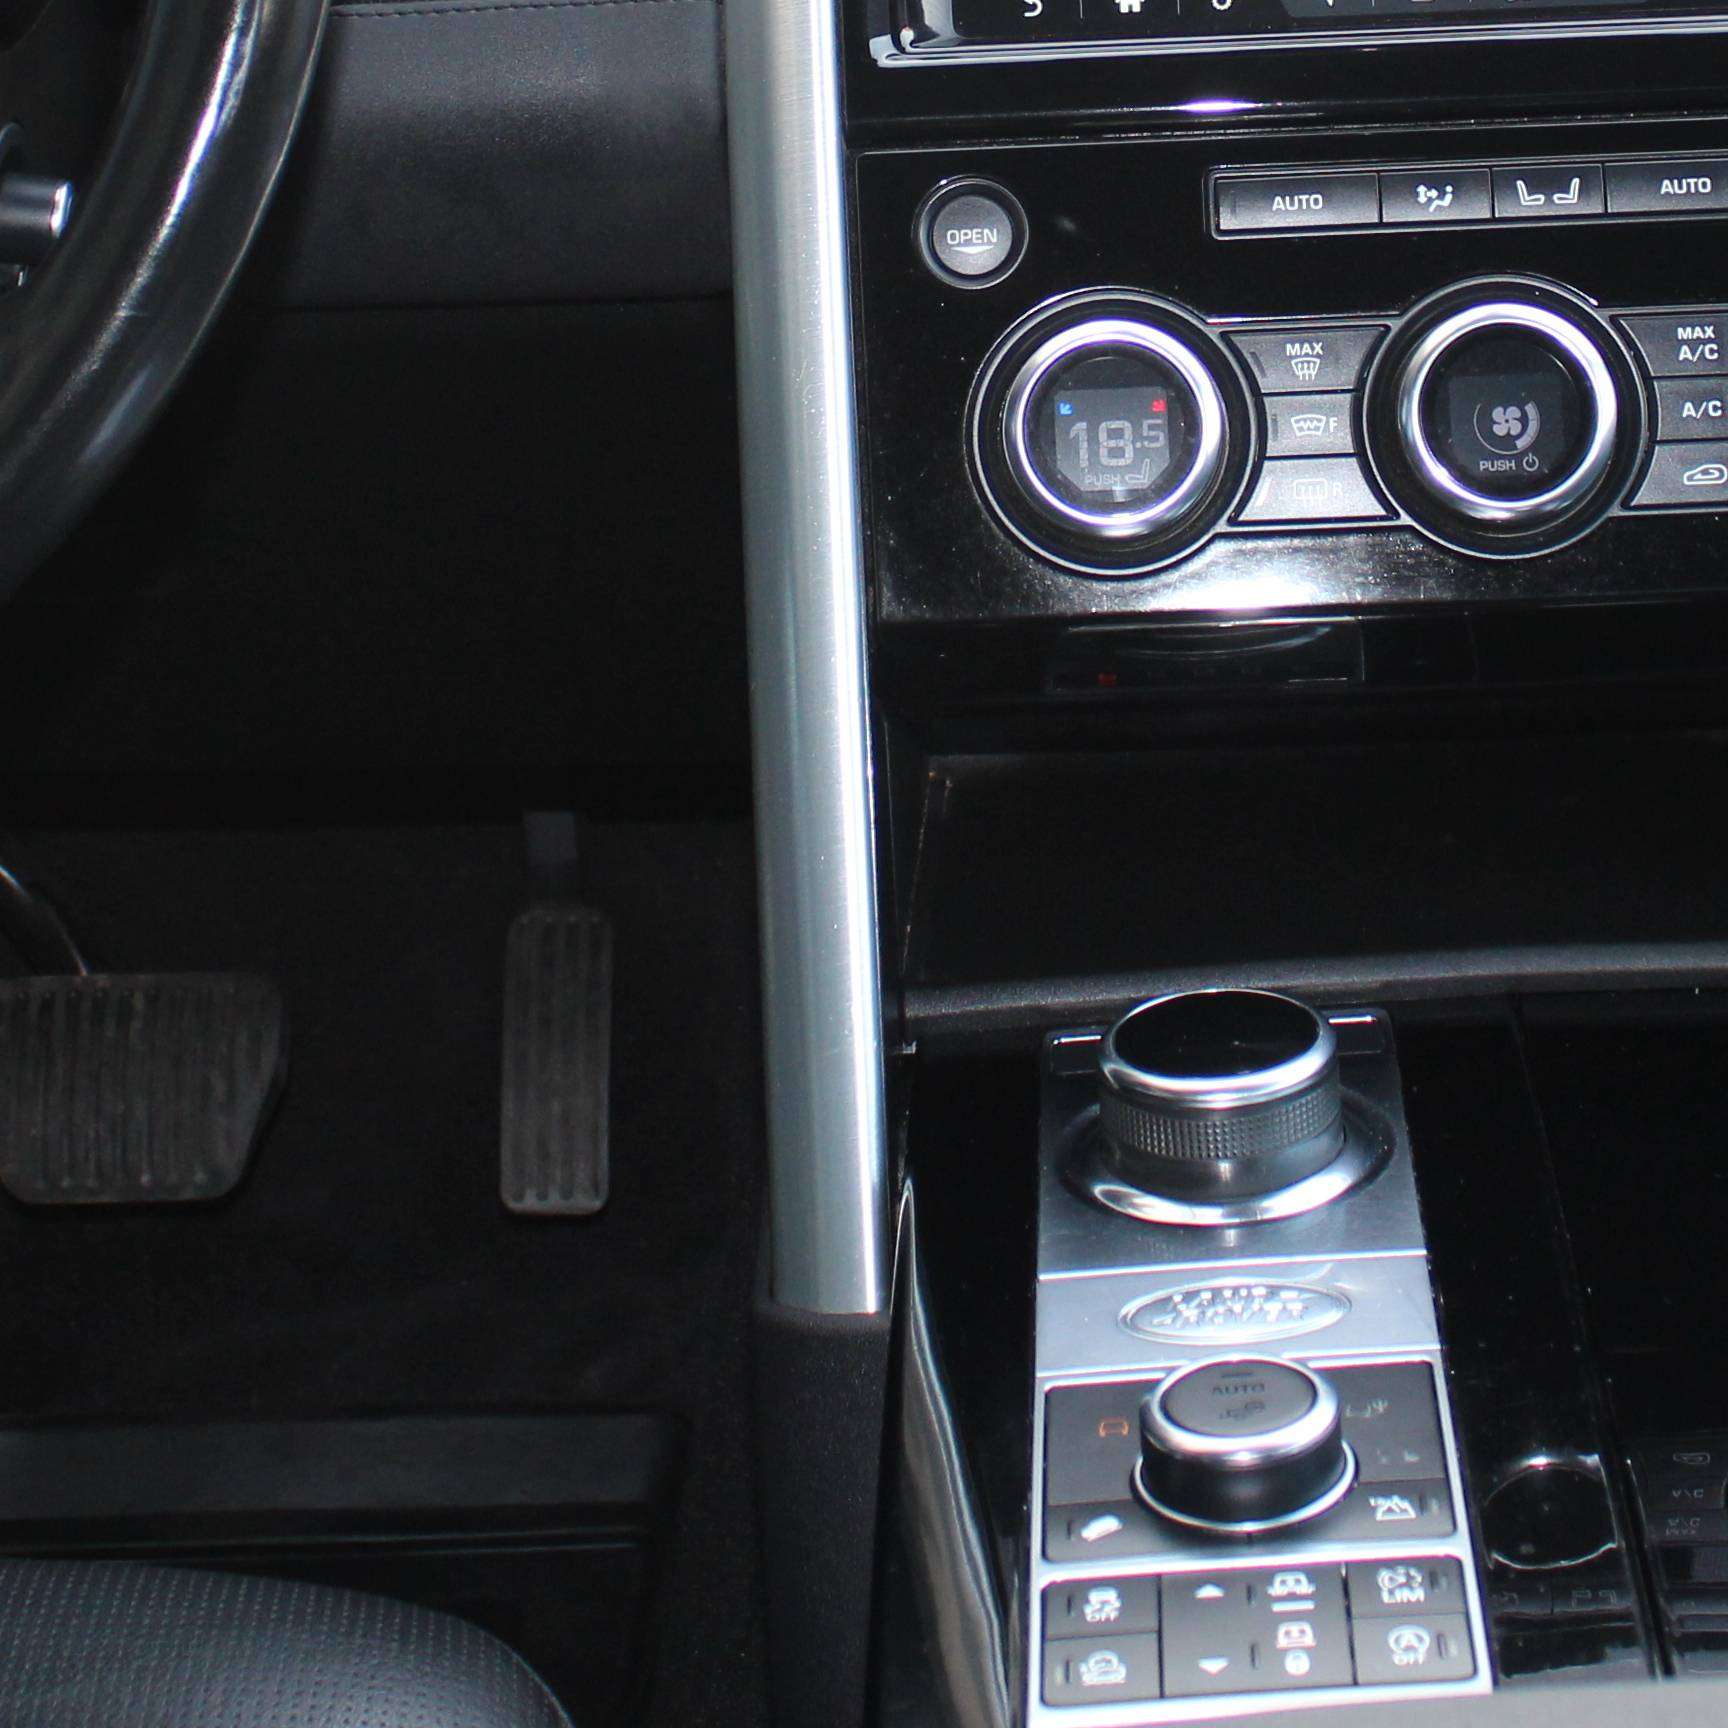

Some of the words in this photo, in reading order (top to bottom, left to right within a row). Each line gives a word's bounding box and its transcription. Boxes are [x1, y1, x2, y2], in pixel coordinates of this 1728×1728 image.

[1660, 177, 1712, 196] AUTO
[1272, 193, 1323, 212] AUTO
[946, 227, 997, 246] OPEN
[1677, 325, 1715, 341] MAX
[1285, 341, 1323, 357] MAX
[1678, 341, 1720, 362] A/C
[1681, 399, 1723, 419] A/C
[1069, 419, 1165, 468] 18.5
[1479, 458, 1516, 472] PUSH
[1084, 473, 1121, 485] PUSH
